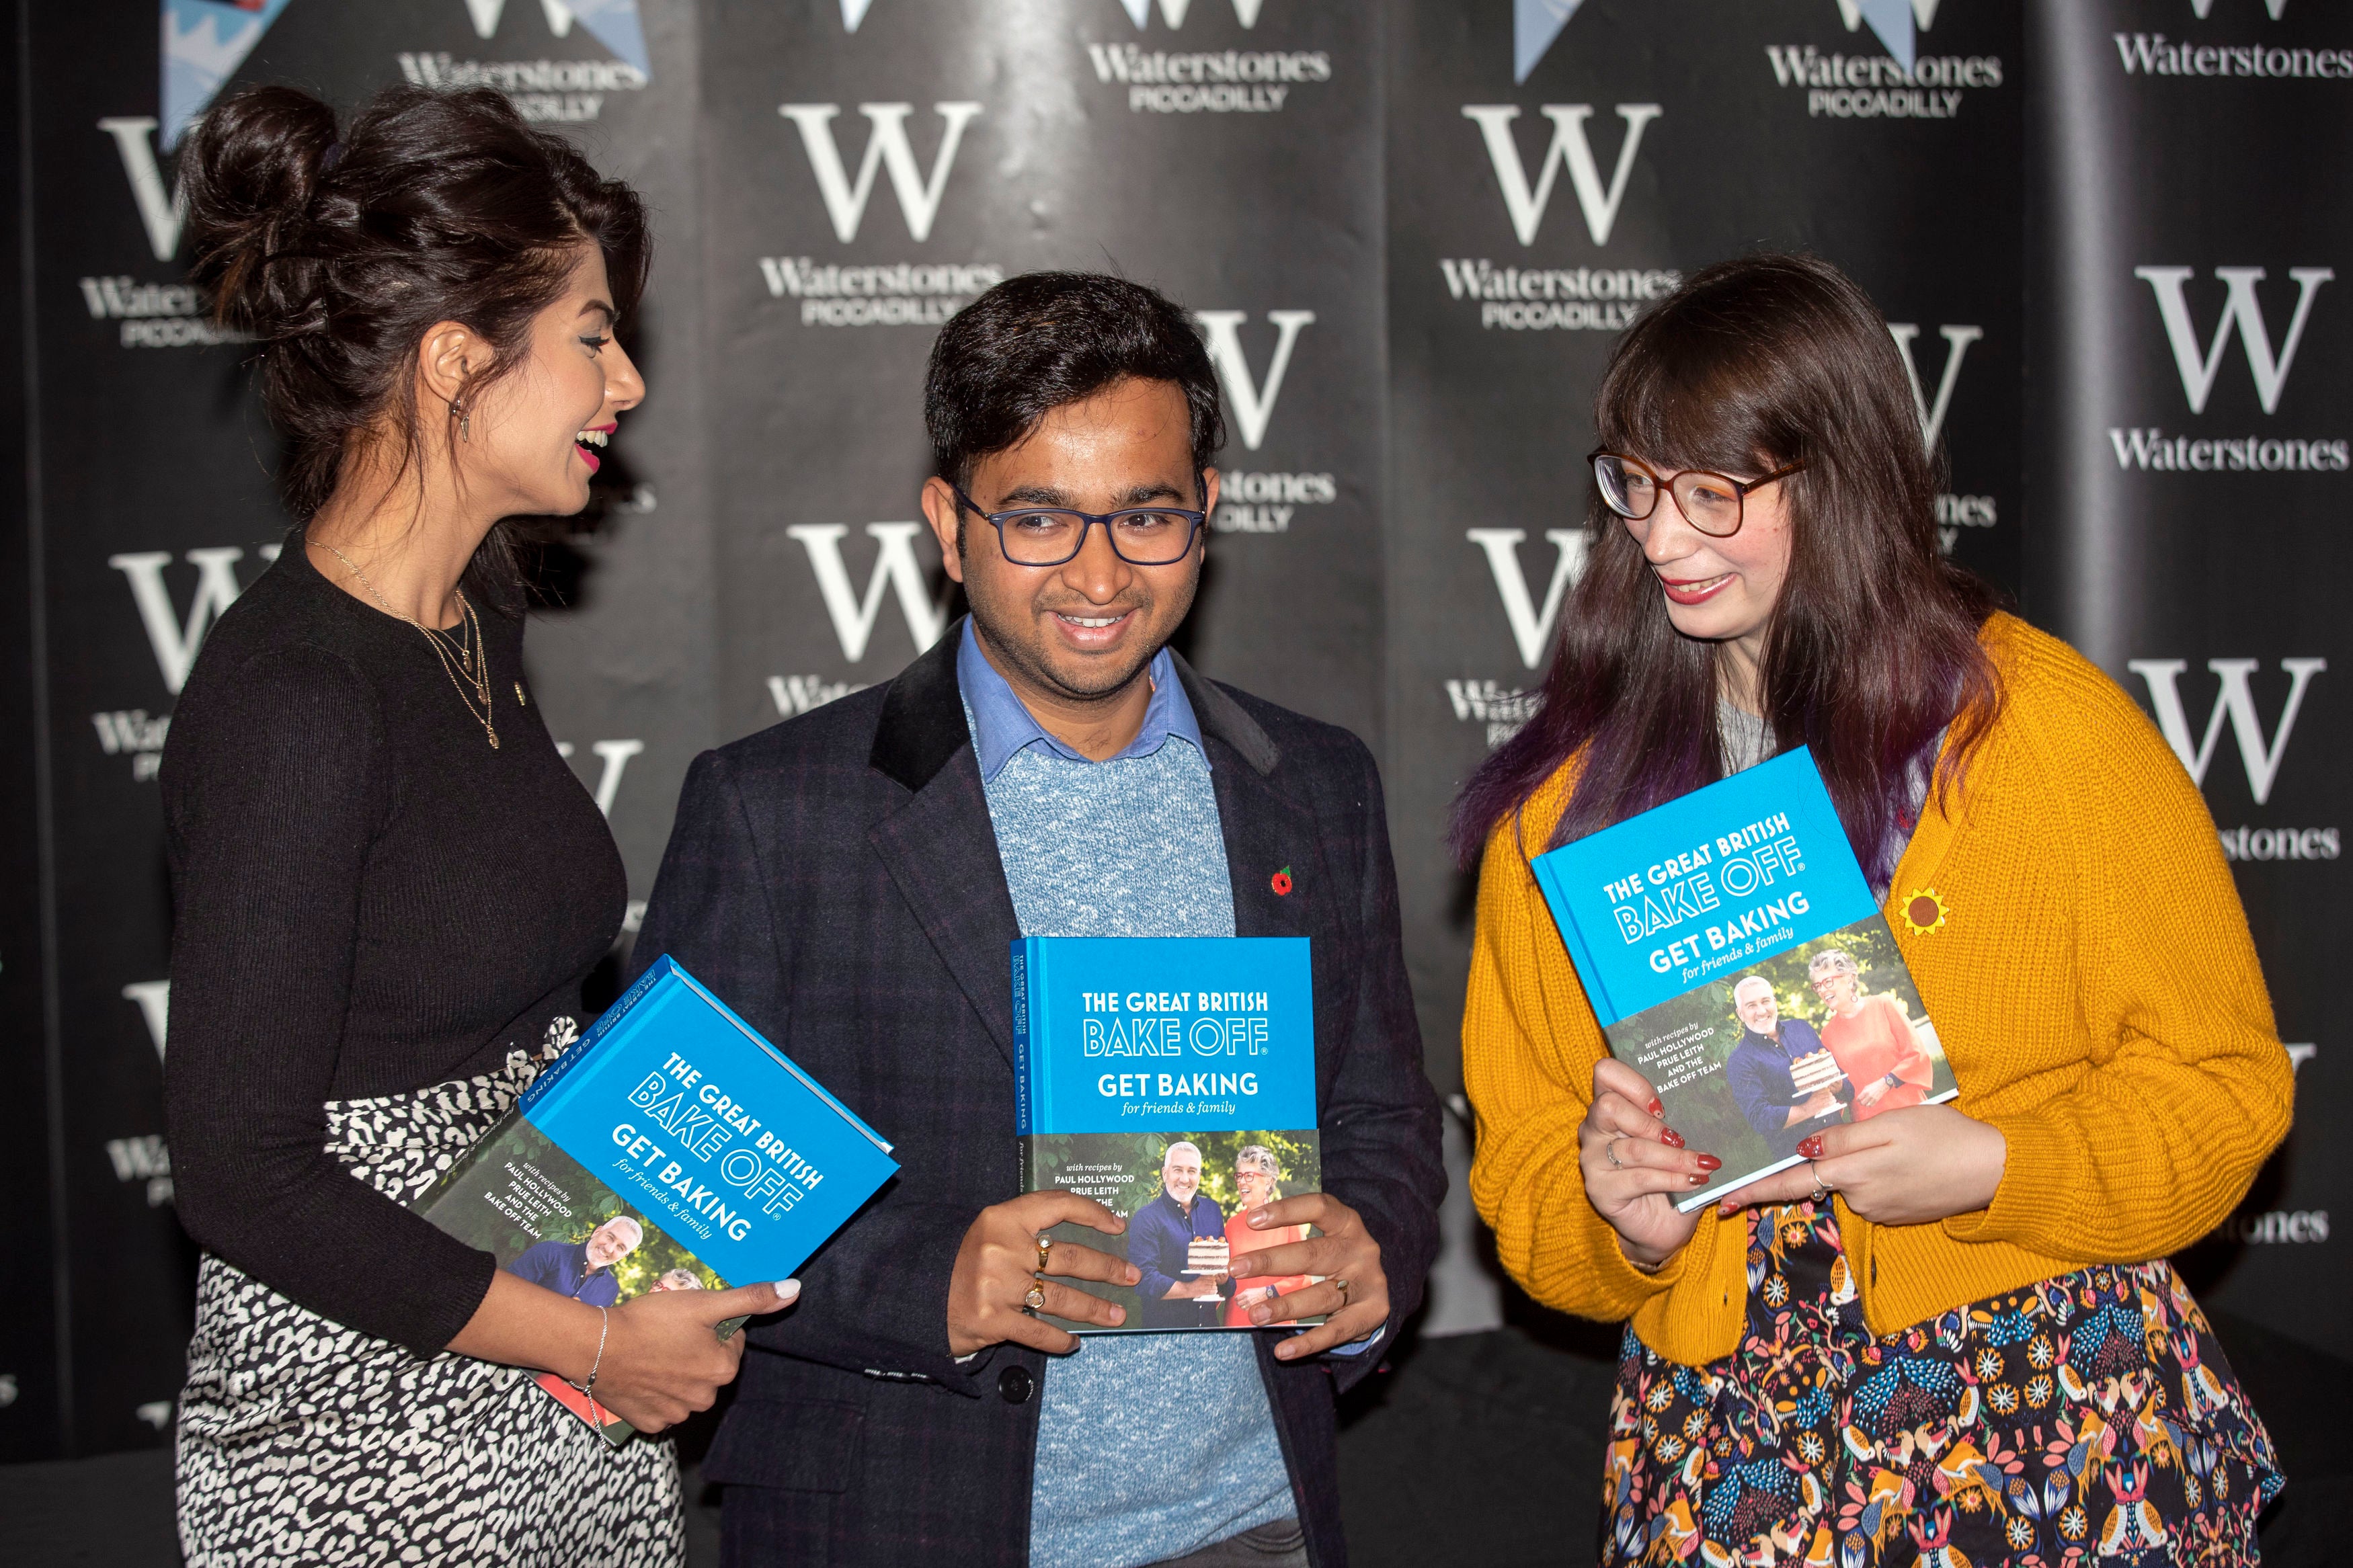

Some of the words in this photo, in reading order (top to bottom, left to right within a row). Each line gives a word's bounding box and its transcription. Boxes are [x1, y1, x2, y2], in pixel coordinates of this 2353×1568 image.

[1088, 42, 1331, 84] Waterstones
[2112, 32, 2353, 78] Waterstones
[1129, 83, 1289, 113] PICCADILLY
[1808, 89, 1962, 118] PICCADILLY
[778, 101, 984, 243] W
[1461, 104, 1663, 246] W
[2132, 265, 2336, 415] W
[2109, 426, 2350, 471] Waterstones
[2127, 657, 2327, 805] W
[1603, 873, 1644, 903] THE
[1648, 843, 1712, 884] GREAT
[1716, 812, 1790, 857] BRITISH
[1613, 872, 1720, 944] BAKE
[1650, 934, 1700, 973] GET
[1705, 891, 1810, 950] BAKING
[1682, 966, 1699, 984] for
[1702, 948, 1743, 976] friends
[1745, 943, 1754, 954] &
[1755, 927, 1794, 952] family
[624, 968, 656, 1005] BAKE
[644, 977, 656, 991] THE
[1012, 955, 1021, 997] BAKE
[621, 991, 643, 1013] GREAT
[1082, 993, 1119, 1012] THE
[1126, 993, 1191, 1012] GREAT
[1199, 992, 1268, 1011] BRITISH
[597, 1013, 621, 1037] BRITISH
[1083, 1017, 1181, 1057] BAKE
[1645, 1036, 1662, 1049] with
[1663, 1026, 1688, 1041] recipes
[1689, 1022, 1698, 1030] by
[569, 1038, 591, 1062] GET
[1638, 1050, 1659, 1065] PAUL
[1660, 1028, 1714, 1055] HOLLYWOOD
[1657, 1054, 1679, 1069] PRUE
[1679, 1043, 1704, 1059] LEITH
[527, 1062, 568, 1103] BAKING
[1098, 1074, 1150, 1097] GET
[1158, 1073, 1258, 1096] BAKING
[1657, 1078, 1679, 1094] BAKE
[1680, 1071, 1696, 1083] OFF
[1697, 1061, 1721, 1076] TEAM
[1669, 1065, 1685, 1077] AND
[1685, 1056, 1703, 1069] THE
[628, 1071, 732, 1163] BAKE
[663, 1052, 702, 1089] THE
[699, 1085, 761, 1137] GREAT
[755, 1131, 824, 1190] BRITISH
[1121, 1102, 1140, 1116] for
[1141, 1102, 1183, 1116] friends
[1187, 1102, 1195, 1113] &
[1197, 1101, 1235, 1115] family
[523, 1163, 539, 1176] with
[538, 1175, 562, 1194] recipes
[561, 1192, 571, 1202] by
[612, 1124, 666, 1167] GET
[658, 1161, 751, 1241] BAKING
[1066, 1163, 1083, 1171] with
[1085, 1163, 1112, 1172] recipes
[1113, 1163, 1122, 1172] by
[1078, 1175, 1134, 1183] HOLLYWOOD
[504, 1162, 524, 1180] PAUL
[523, 1178, 571, 1217] HOLLYWOOD
[504, 1194, 523, 1208] AND
[522, 1206, 539, 1221] THE
[508, 1181, 530, 1200] PRUE
[528, 1196, 552, 1216] LEITH
[612, 1159, 634, 1173] for
[628, 1172, 669, 1204] friends
[668, 1202, 679, 1212] &
[674, 1209, 712, 1239] family
[1071, 1187, 1092, 1195] PRUE
[1094, 1187, 1119, 1195] LEITH
[484, 1192, 506, 1210] BAKE
[505, 1208, 522, 1221] OFF
[520, 1219, 542, 1239] TEAM
